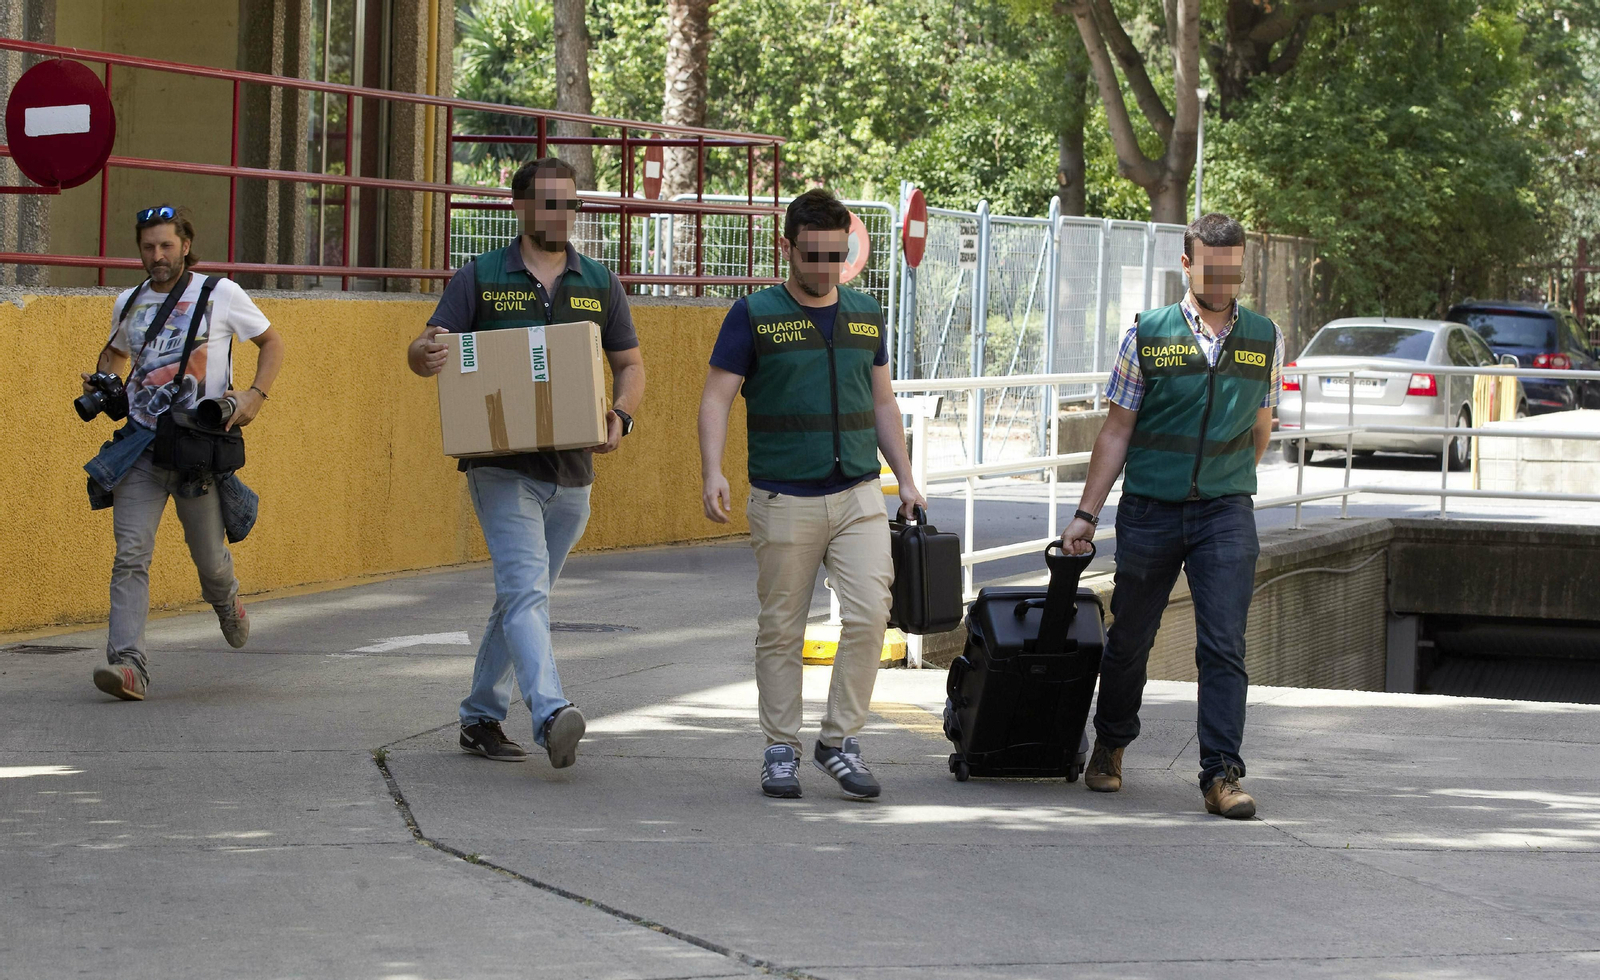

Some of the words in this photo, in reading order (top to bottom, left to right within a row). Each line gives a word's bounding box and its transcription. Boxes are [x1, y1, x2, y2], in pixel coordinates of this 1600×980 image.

[482, 291, 537, 302] GUARDIA
[494, 301, 527, 312] CIVIL
[572, 298, 600, 310] UCO
[756, 319, 816, 334] GUARDIA
[851, 323, 877, 335] UCO
[772, 331, 807, 344] CIVIL
[1141, 344, 1199, 357] GUARDIA
[532, 344, 547, 371] CIVIL
[1154, 356, 1188, 368] CIVIL
[1236, 351, 1265, 364] UCO
